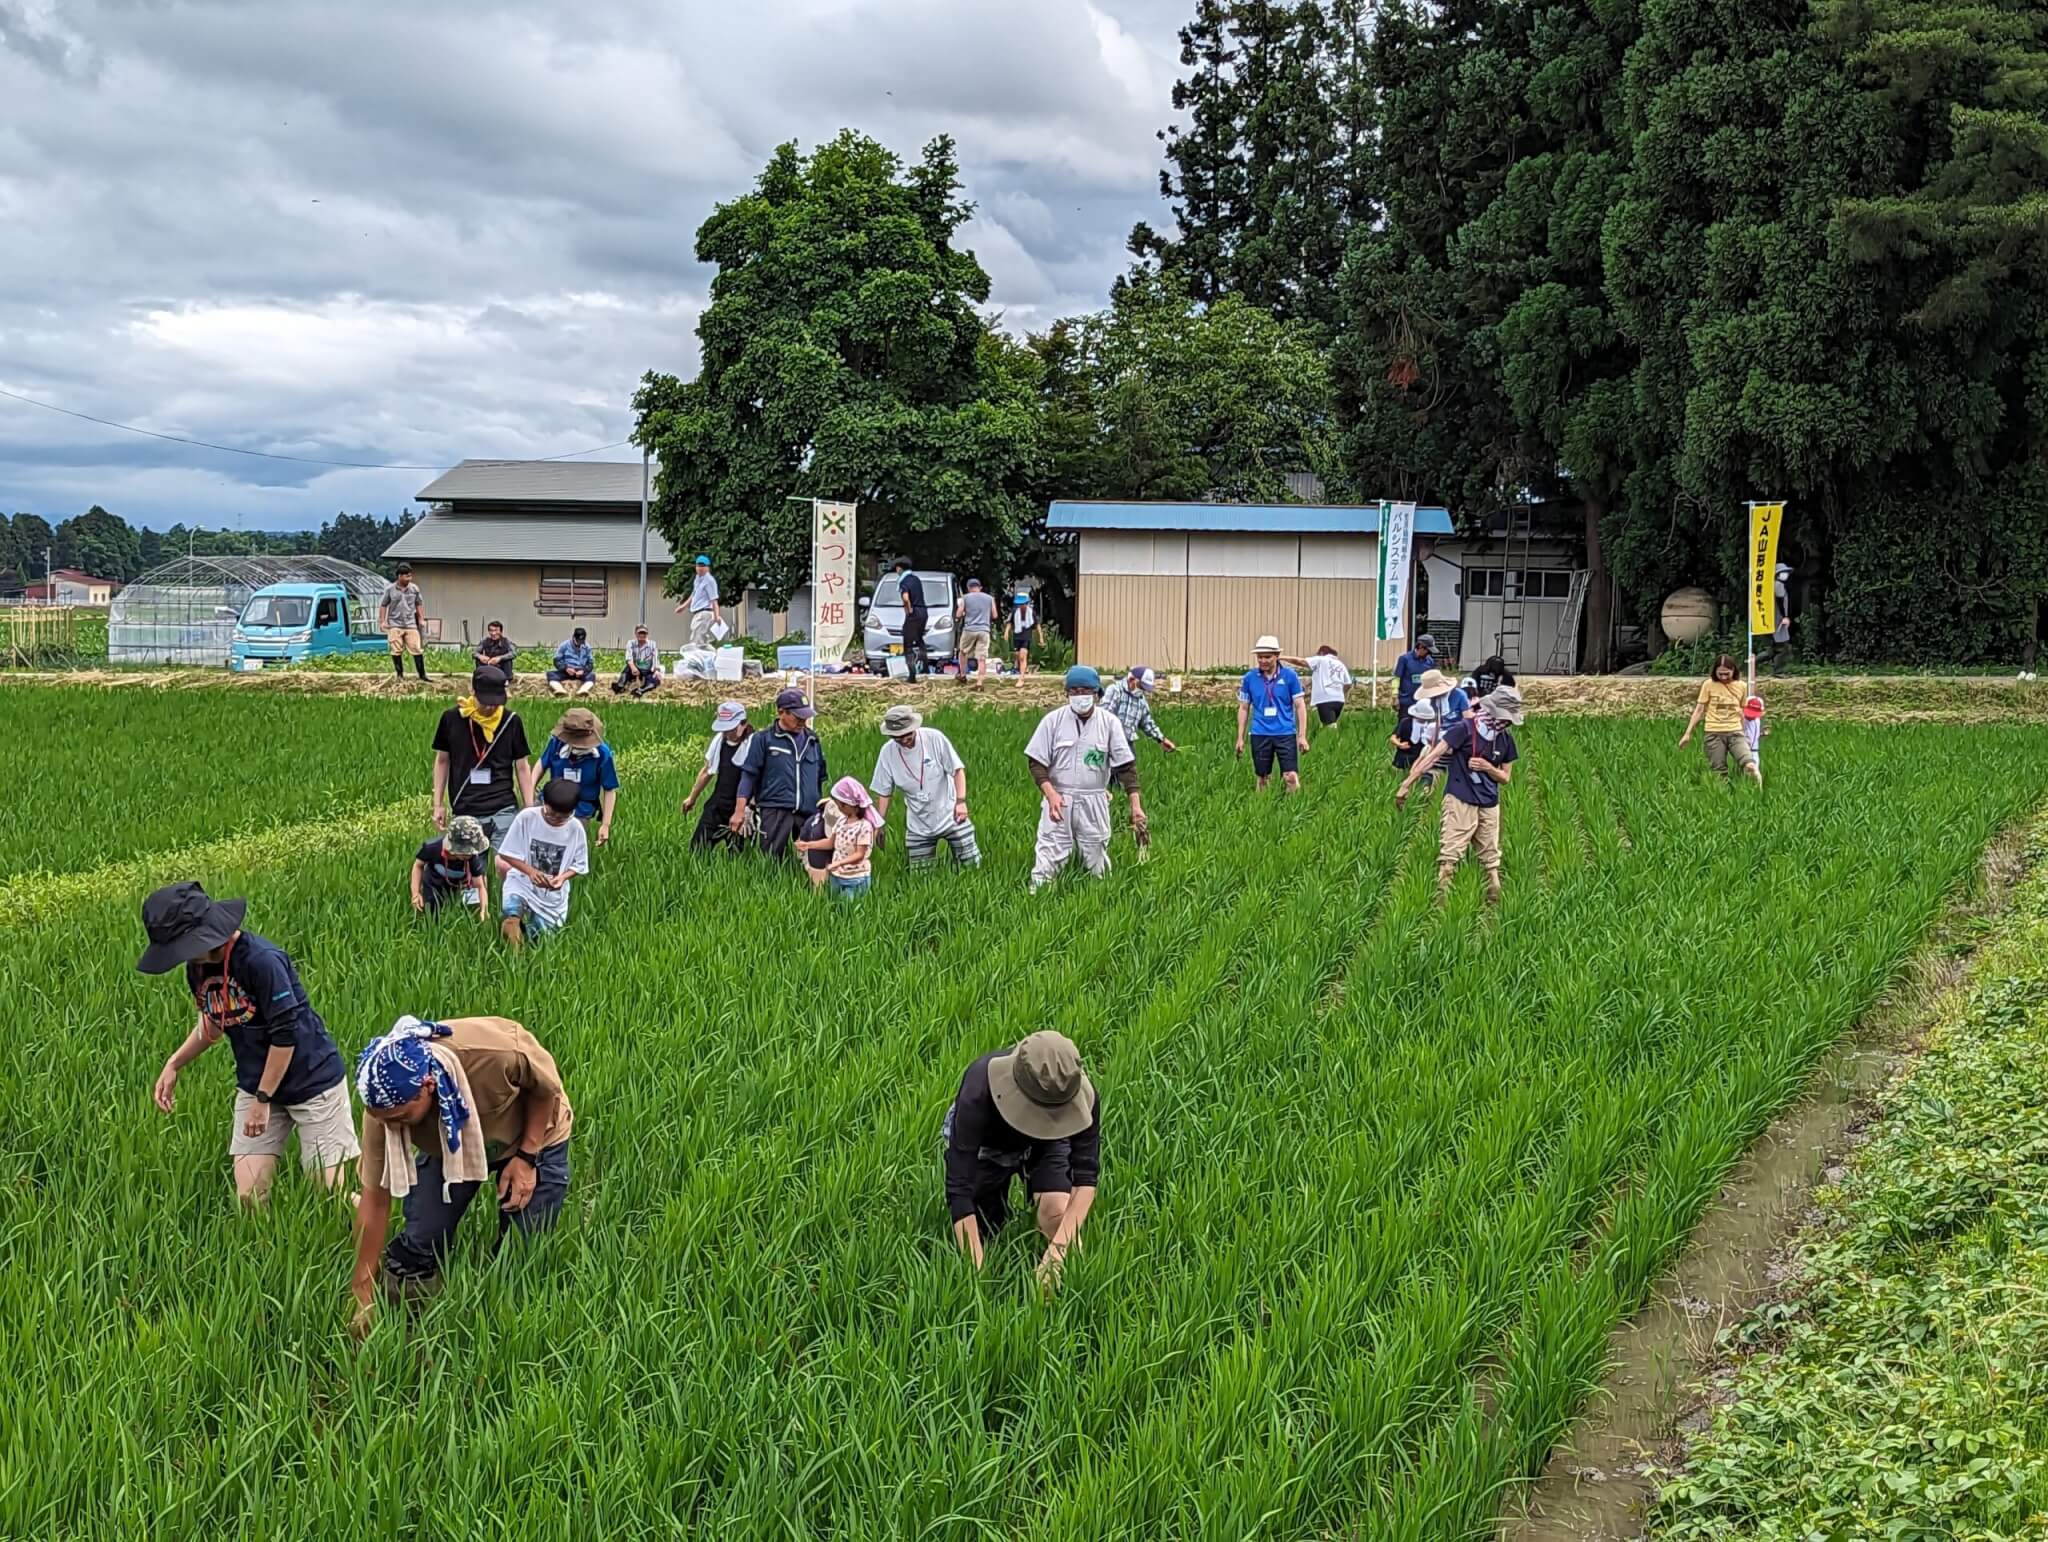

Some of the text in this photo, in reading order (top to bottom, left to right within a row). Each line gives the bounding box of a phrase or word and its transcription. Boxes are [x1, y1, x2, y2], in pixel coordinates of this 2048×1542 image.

[819, 544, 845, 625] つや姫
[1388, 512, 1402, 609] パルシステム東京
